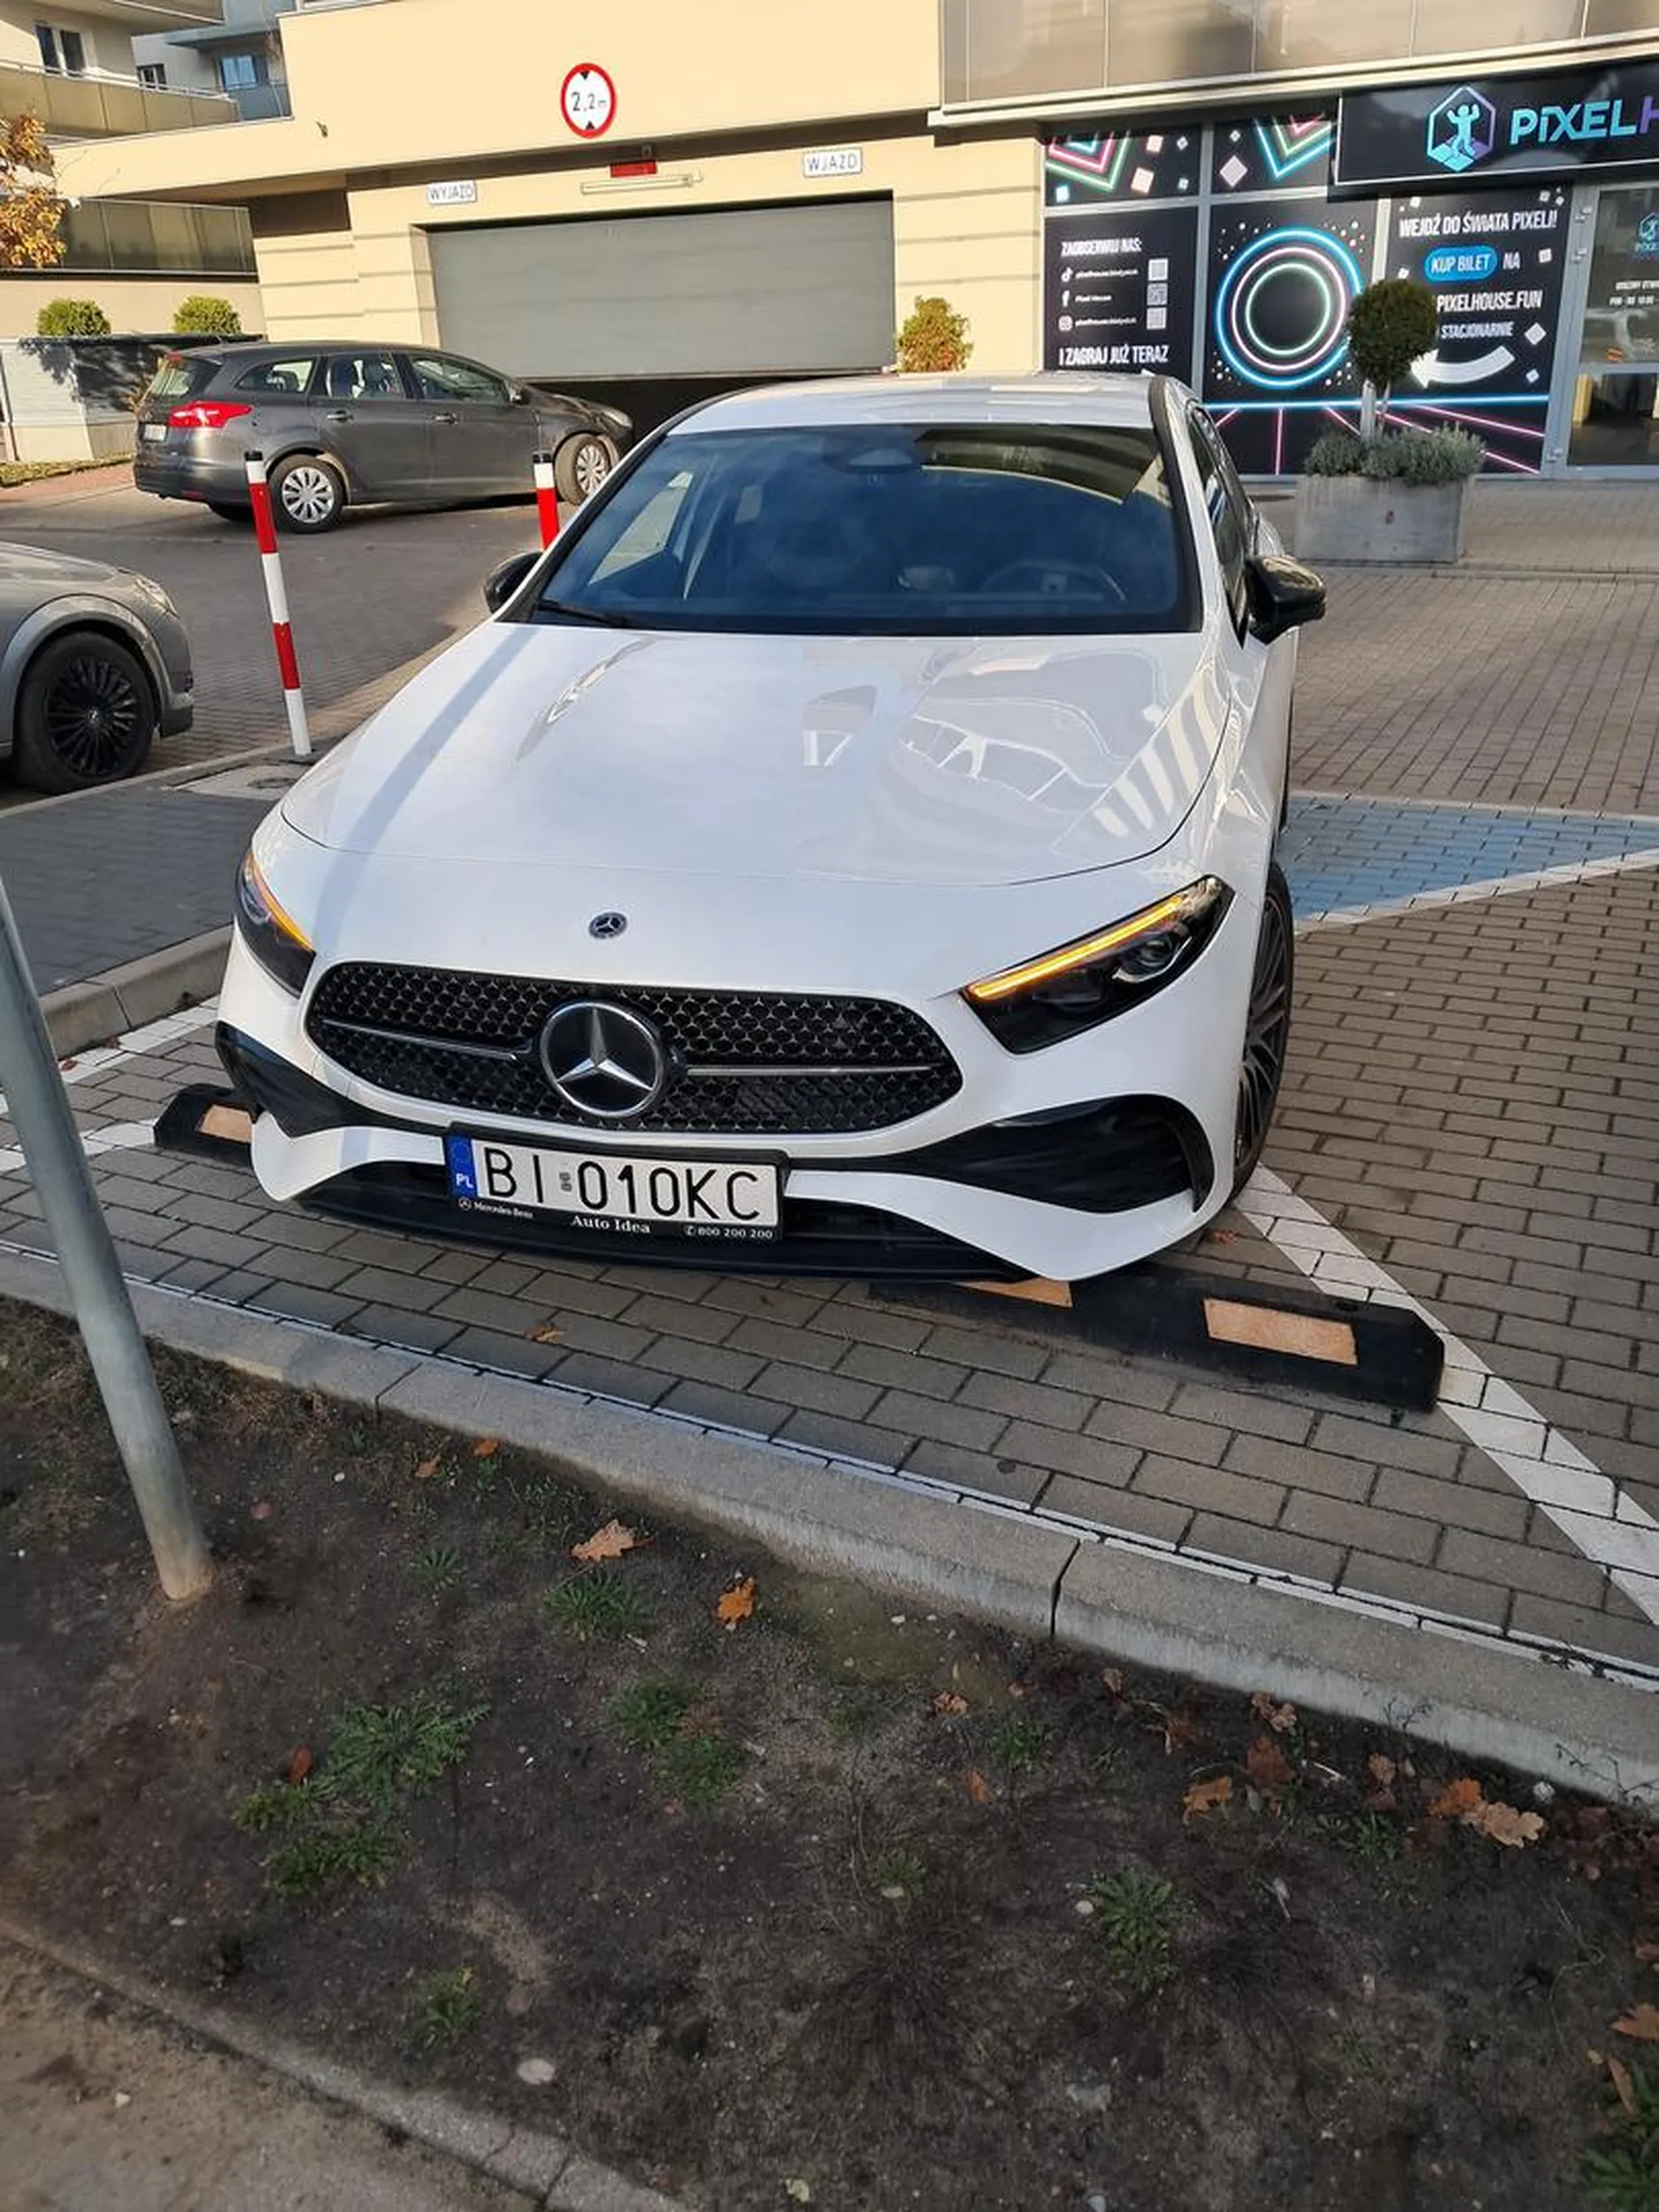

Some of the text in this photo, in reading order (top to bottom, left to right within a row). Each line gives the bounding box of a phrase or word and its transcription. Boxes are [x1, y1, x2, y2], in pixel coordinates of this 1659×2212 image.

[806, 153, 858, 172] WJAZD
[429, 184, 474, 201] WYJAZD
[1442, 215, 1461, 234] DO
[1431, 253, 1491, 273] KUP BILET
[1502, 251, 1520, 269] NA
[1436, 289, 1543, 312] PIXELHOUSE.FUN
[1065, 346, 1108, 365] ZAGRAJ
[1132, 344, 1169, 363] TERAZ
[456, 1172, 474, 1188] PL
[484, 1146, 760, 1222] BI 010KC
[571, 1215, 651, 1234] Auto Idea
[697, 1226, 773, 1240] 800 200 200
